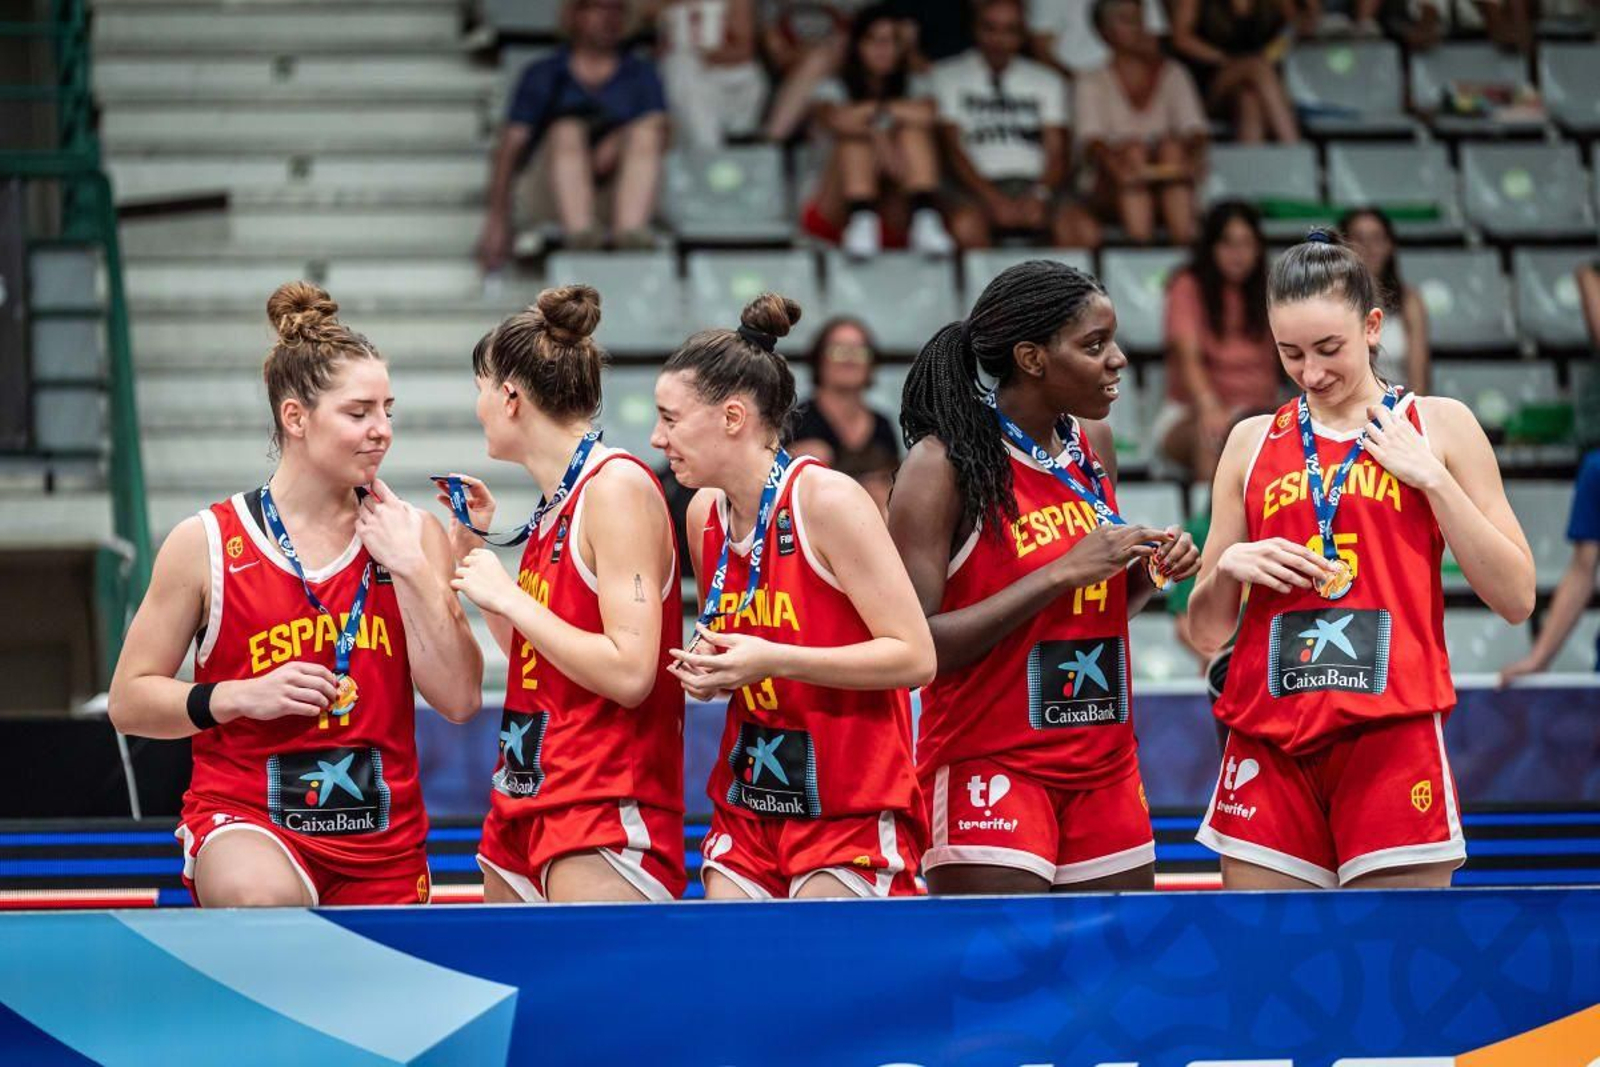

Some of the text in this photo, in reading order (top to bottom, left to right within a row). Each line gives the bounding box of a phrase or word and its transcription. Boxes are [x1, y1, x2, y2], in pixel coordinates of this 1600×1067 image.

[1010, 501, 1098, 558] ESPA
[1282, 668, 1369, 691] CaixaBank
[1044, 702, 1116, 724] CaixaBank
[285, 812, 376, 832] CaixaBank
